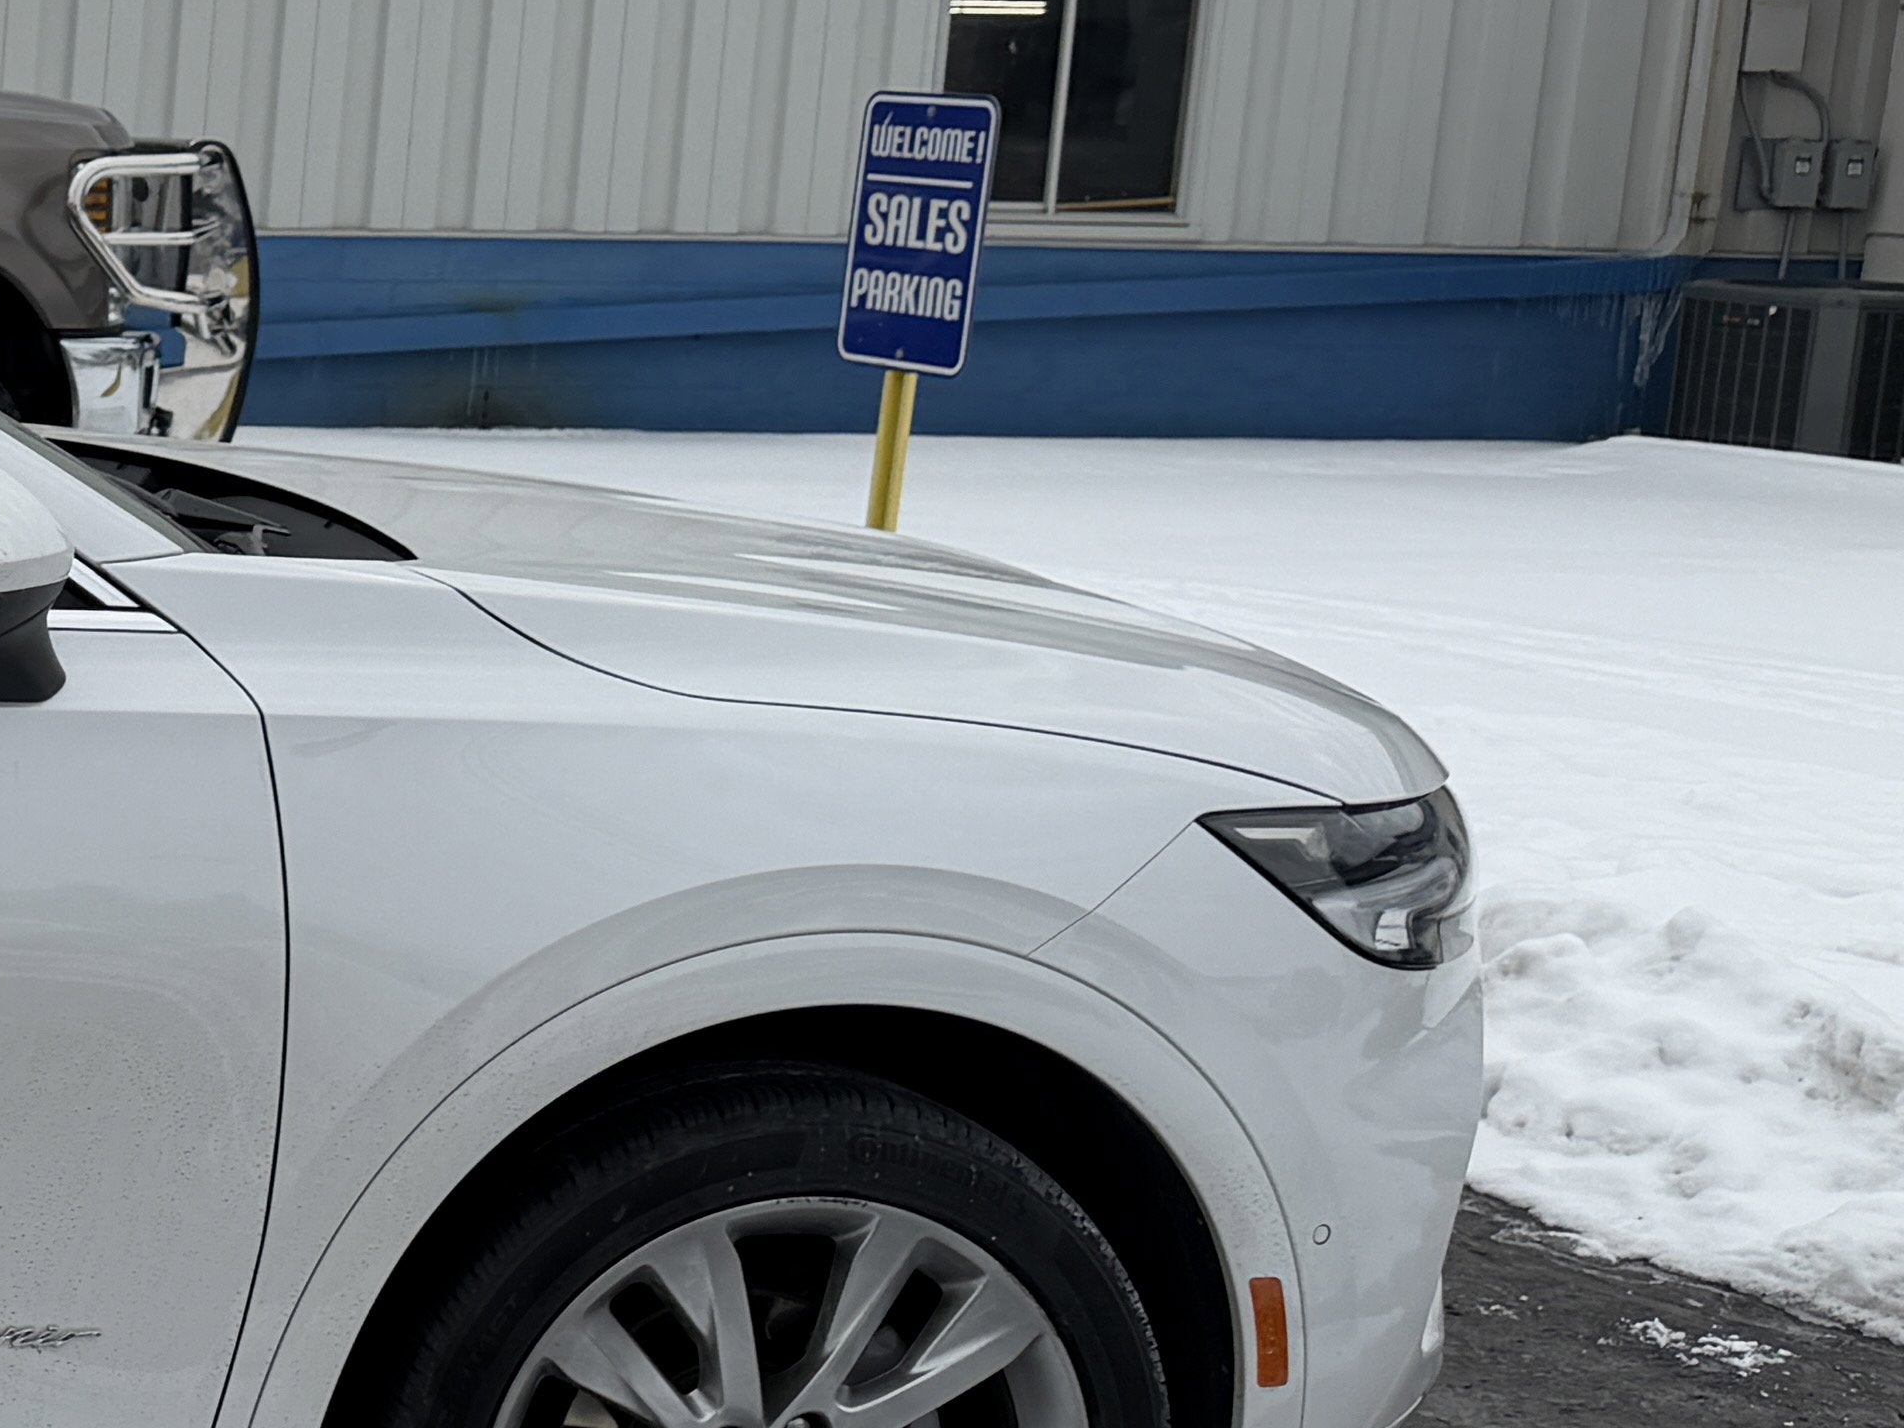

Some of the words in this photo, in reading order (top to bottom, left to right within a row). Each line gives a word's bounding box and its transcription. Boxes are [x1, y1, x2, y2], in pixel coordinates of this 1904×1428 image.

[871, 111, 986, 163] WELCOME!
[864, 192, 971, 255] SALES
[850, 268, 963, 321] PARKING
